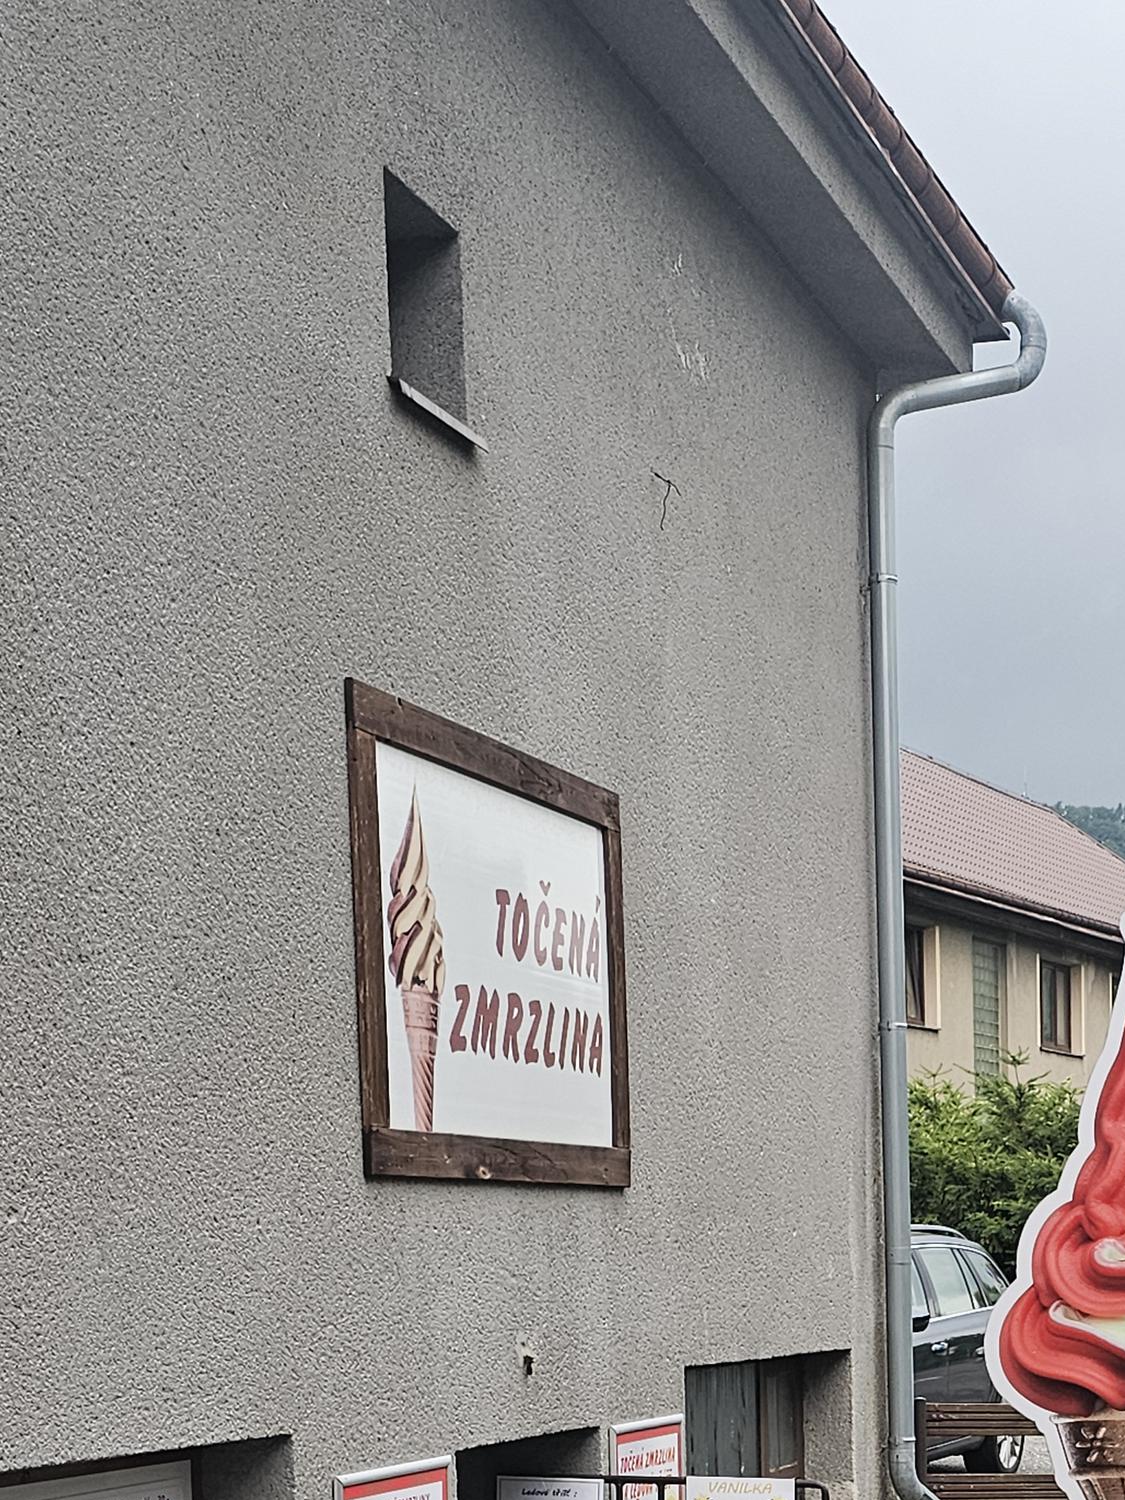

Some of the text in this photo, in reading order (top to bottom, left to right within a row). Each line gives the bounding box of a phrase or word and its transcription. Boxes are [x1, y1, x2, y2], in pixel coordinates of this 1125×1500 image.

[495, 880, 601, 983] TOČENÁ
[449, 983, 604, 1078] ZMRZLINA
[620, 1446, 675, 1474] TOČENÁ ZMRZLINA
[708, 1481, 773, 1494] VANILKA
